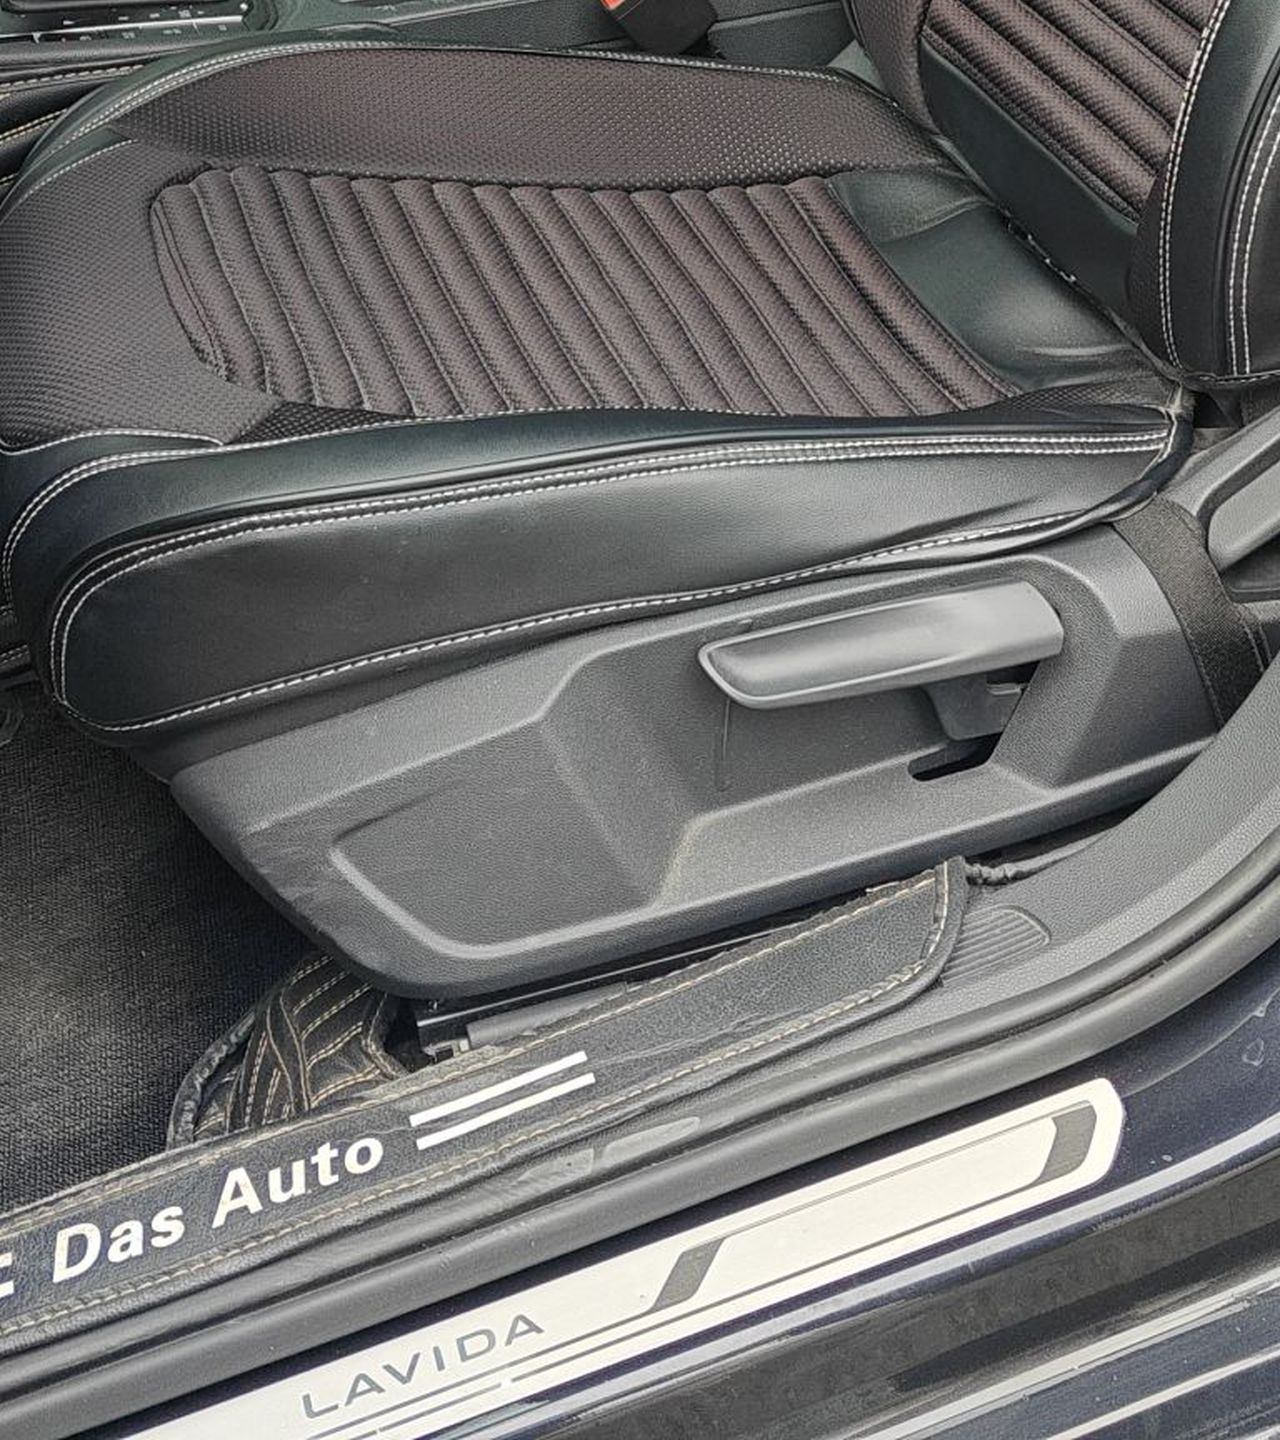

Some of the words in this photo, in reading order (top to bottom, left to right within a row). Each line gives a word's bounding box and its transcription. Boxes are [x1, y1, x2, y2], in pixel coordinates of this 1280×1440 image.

[52, 1205, 186, 1283] Das
[211, 1137, 384, 1229] Auto
[302, 1314, 545, 1419] LAVIDA
